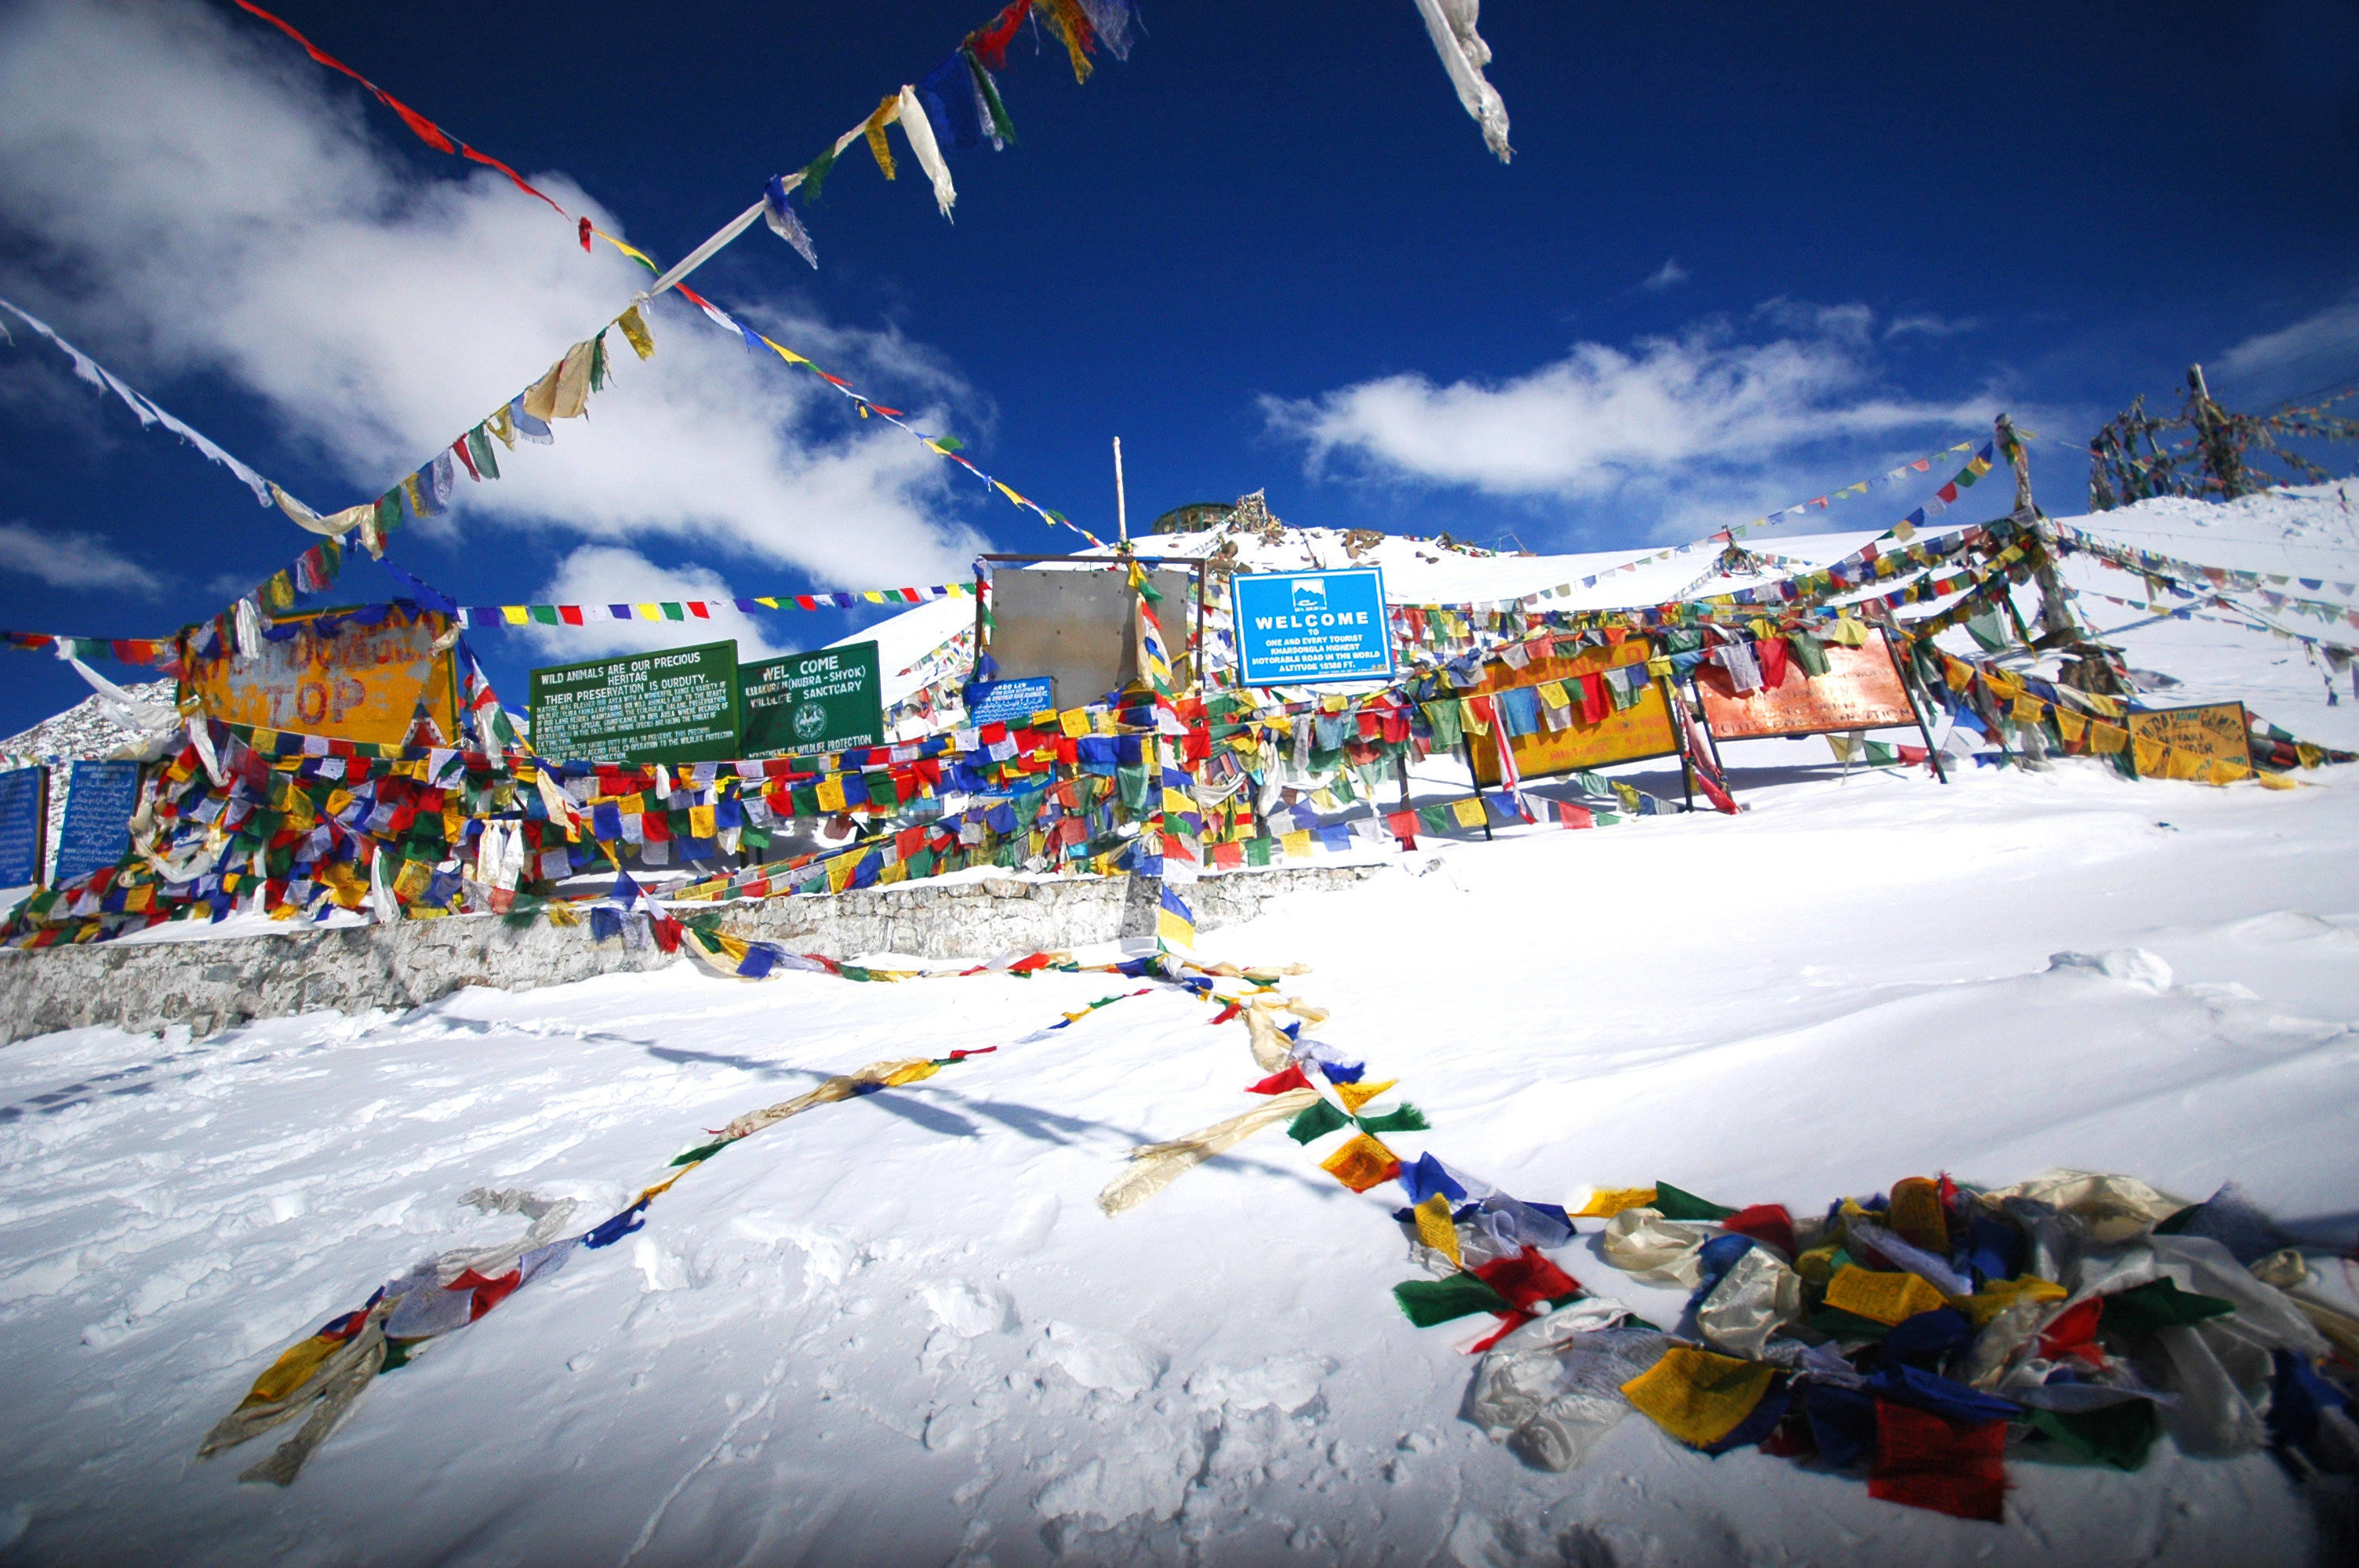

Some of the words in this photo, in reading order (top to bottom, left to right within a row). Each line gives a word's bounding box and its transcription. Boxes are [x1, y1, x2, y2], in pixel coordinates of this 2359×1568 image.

[1255, 612, 1369, 630] WELCOME
[1302, 636, 1328, 644] EVERY
[1329, 634, 1363, 643] TOURIST
[1270, 645, 1325, 655] KHARDONGLA
[1252, 655, 1300, 665] MOTORABLE
[1302, 654, 1323, 662] ROAD
[1279, 663, 1318, 672] ALTITUDE
[541, 673, 564, 685] WILD
[566, 666, 604, 681] ANIMALS
[608, 663, 626, 676] ARE
[631, 659, 650, 672] OUR
[654, 652, 700, 669] PRECIOUS
[763, 666, 790, 682] WEL
[800, 655, 838, 674] COME
[608, 671, 648, 687] HERITAG
[544, 693, 572, 706] THEIR
[576, 681, 644, 701] PRESERVATION
[649, 679, 658, 691] IS
[803, 681, 862, 699] SANCTUARY
[264, 677, 366, 729] TOP
[827, 734, 872, 750] PROTECTION
